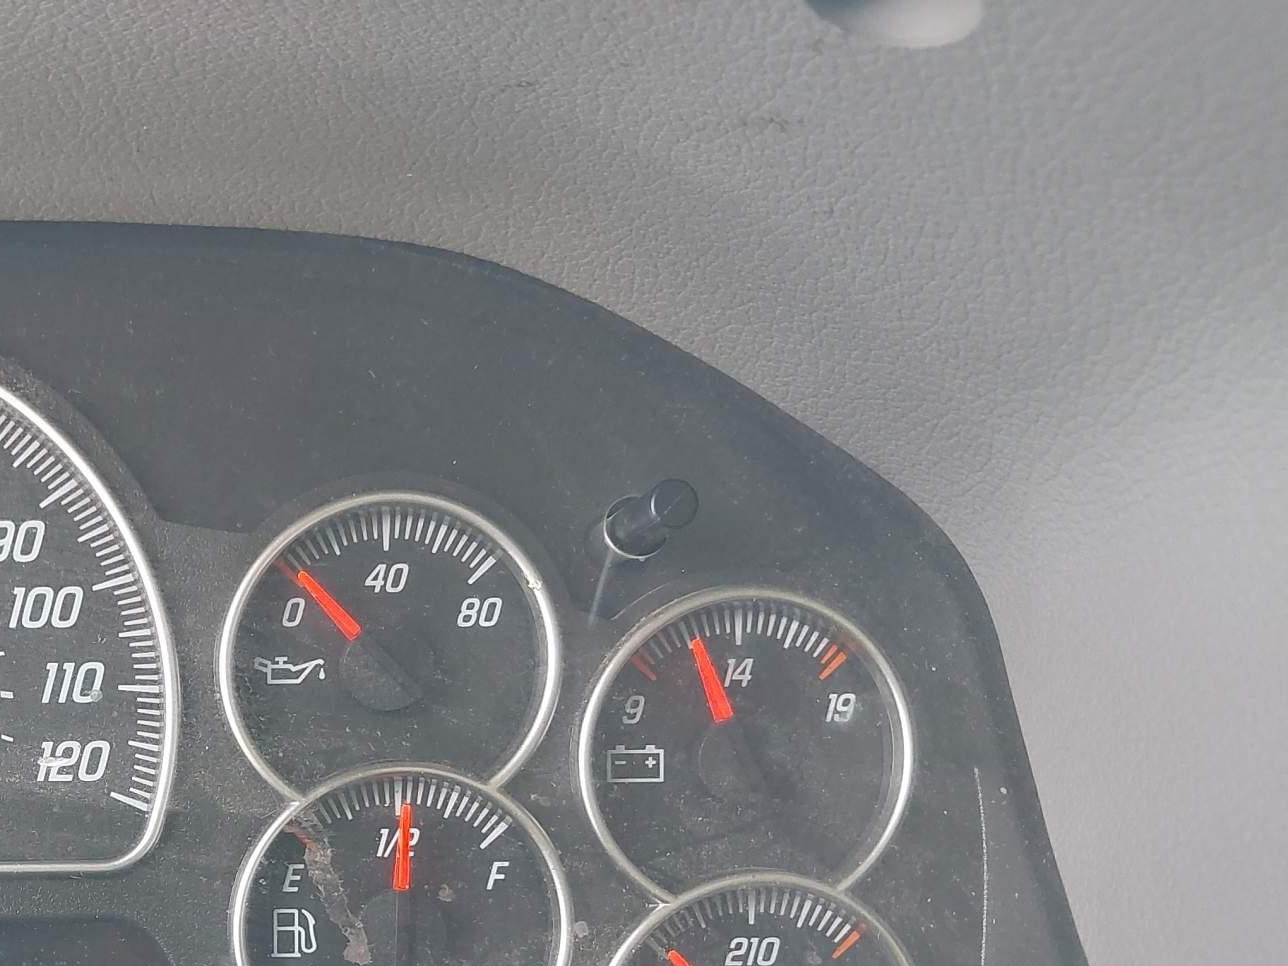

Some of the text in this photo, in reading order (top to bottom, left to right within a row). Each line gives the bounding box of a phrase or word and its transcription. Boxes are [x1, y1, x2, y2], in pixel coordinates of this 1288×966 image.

[365, 564, 408, 592] 40
[9, 586, 83, 628] 100
[283, 598, 305, 627] 0
[457, 598, 502, 627] 80
[42, 662, 104, 703] 110
[724, 659, 754, 687] 14
[622, 695, 645, 724] 9
[826, 694, 856, 722] 19
[37, 741, 110, 781] 120
[283, 864, 304, 892] E
[487, 862, 509, 889] F
[725, 937, 780, 966] 210
